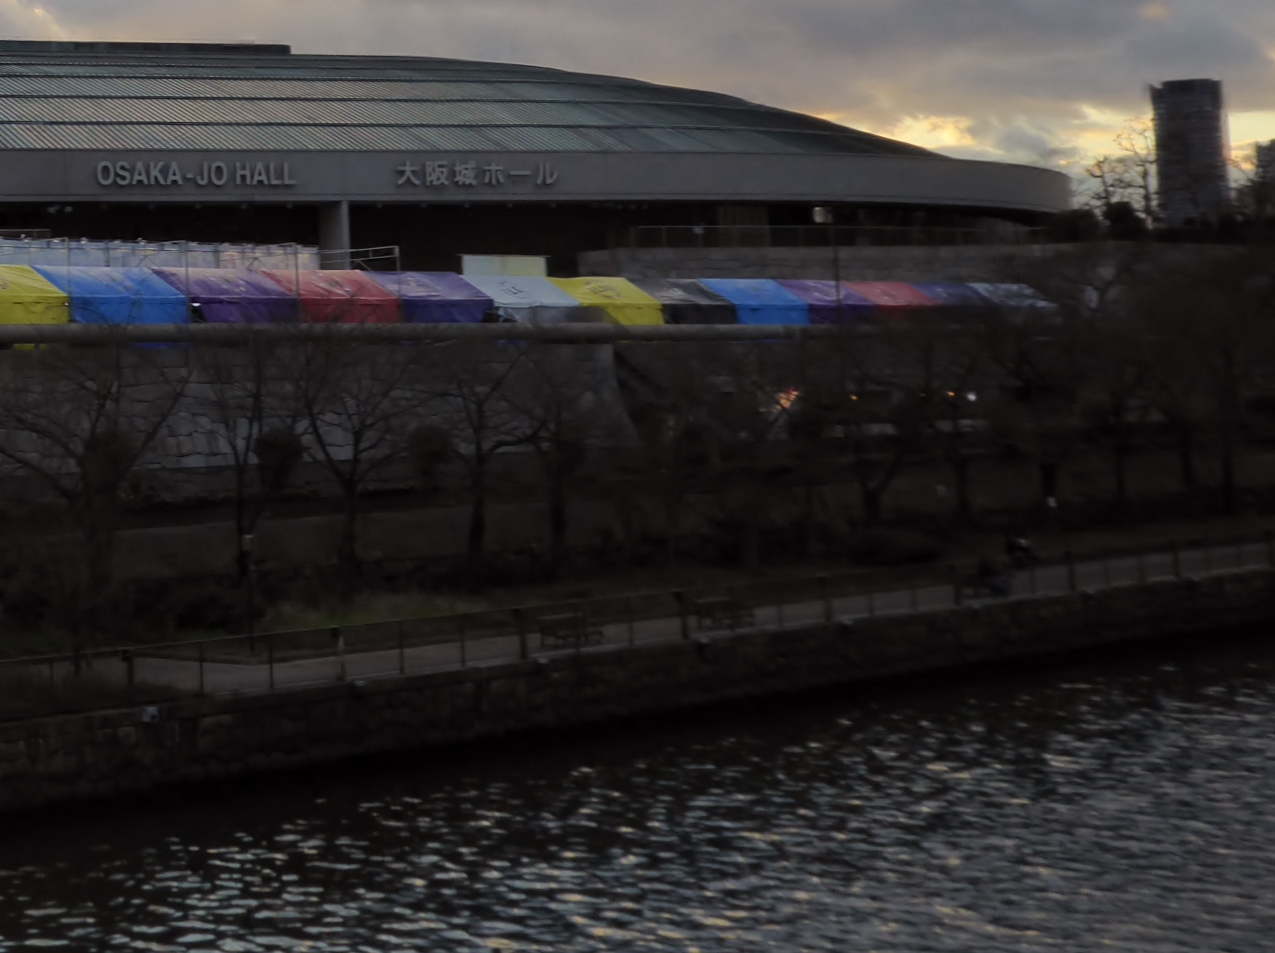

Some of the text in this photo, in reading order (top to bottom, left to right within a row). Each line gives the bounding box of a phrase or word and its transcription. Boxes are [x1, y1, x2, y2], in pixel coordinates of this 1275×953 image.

[96, 160, 297, 186] OSAKA-JO HALL
[396, 159, 558, 186] 大阪城ホール
